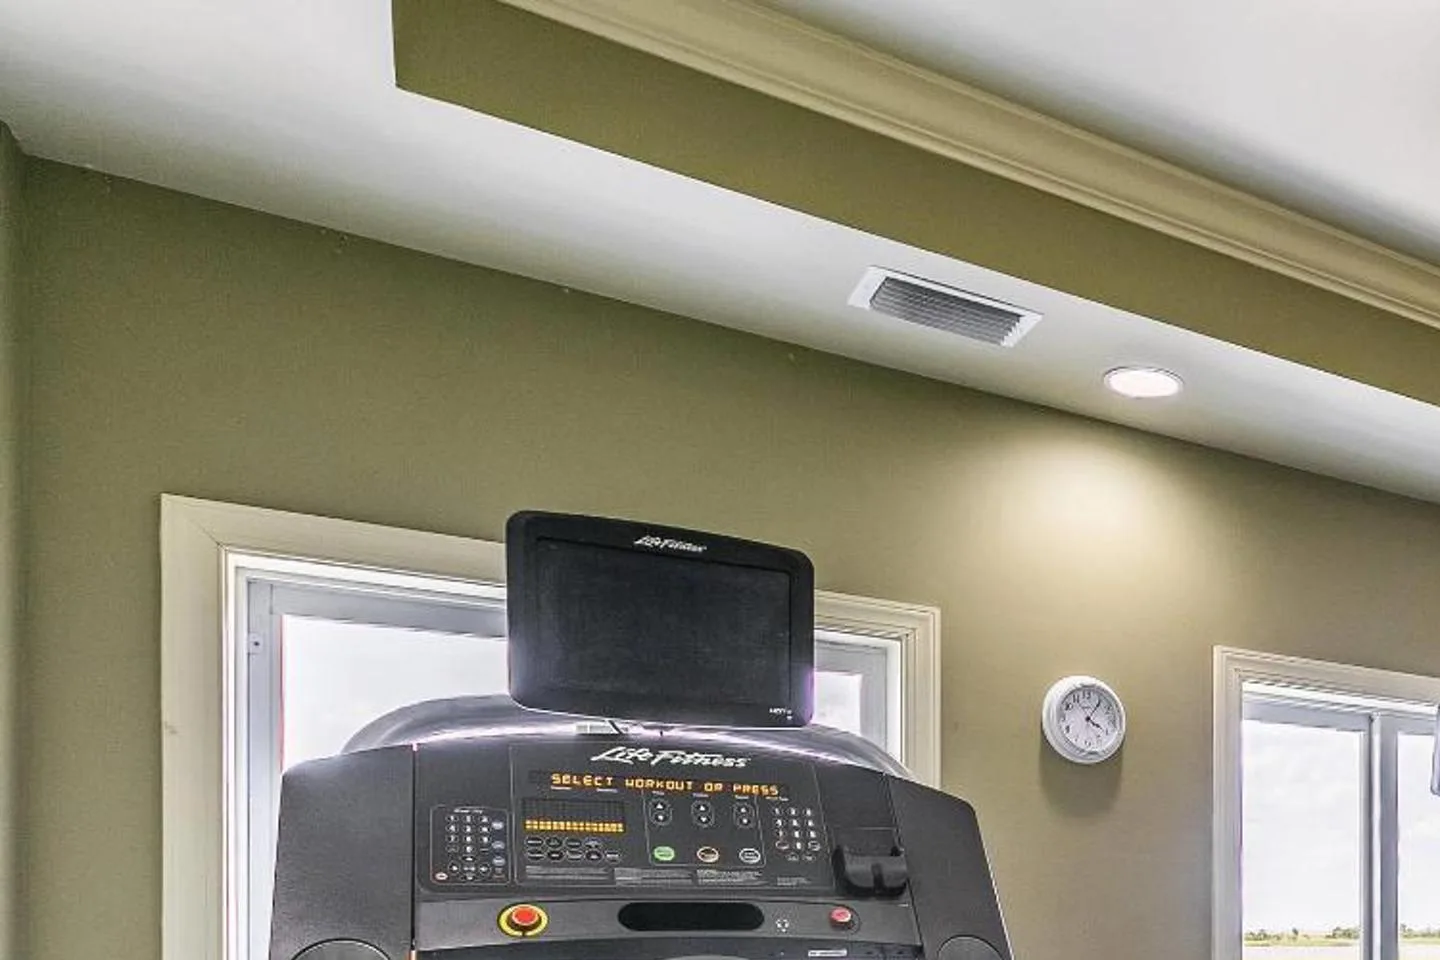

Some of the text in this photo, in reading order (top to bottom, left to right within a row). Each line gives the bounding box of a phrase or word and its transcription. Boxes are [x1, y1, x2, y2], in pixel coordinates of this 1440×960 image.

[551, 772, 779, 796] SELECT WORKOUT OR PRESS
